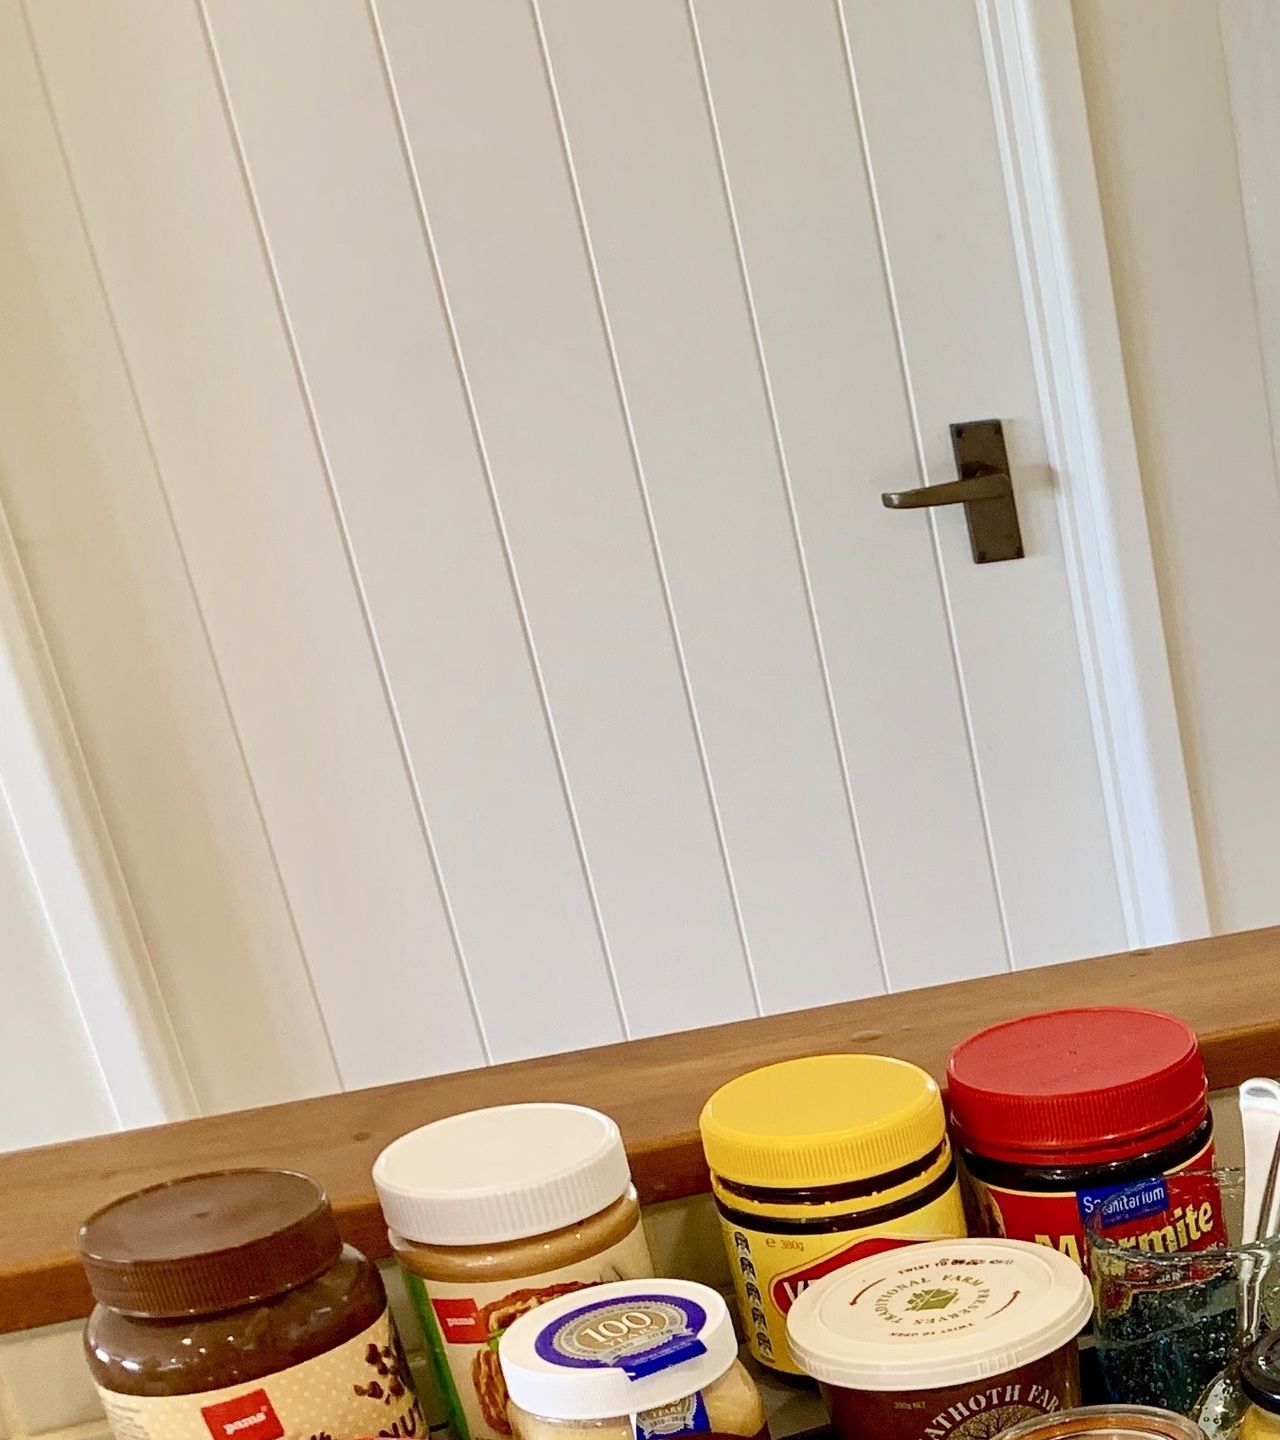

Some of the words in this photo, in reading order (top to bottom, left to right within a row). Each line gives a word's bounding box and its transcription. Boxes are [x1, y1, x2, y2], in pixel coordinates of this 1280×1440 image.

[581, 1311, 652, 1344] 100
[1027, 1384, 1063, 1413] FAR
[223, 1411, 266, 1436] pams
